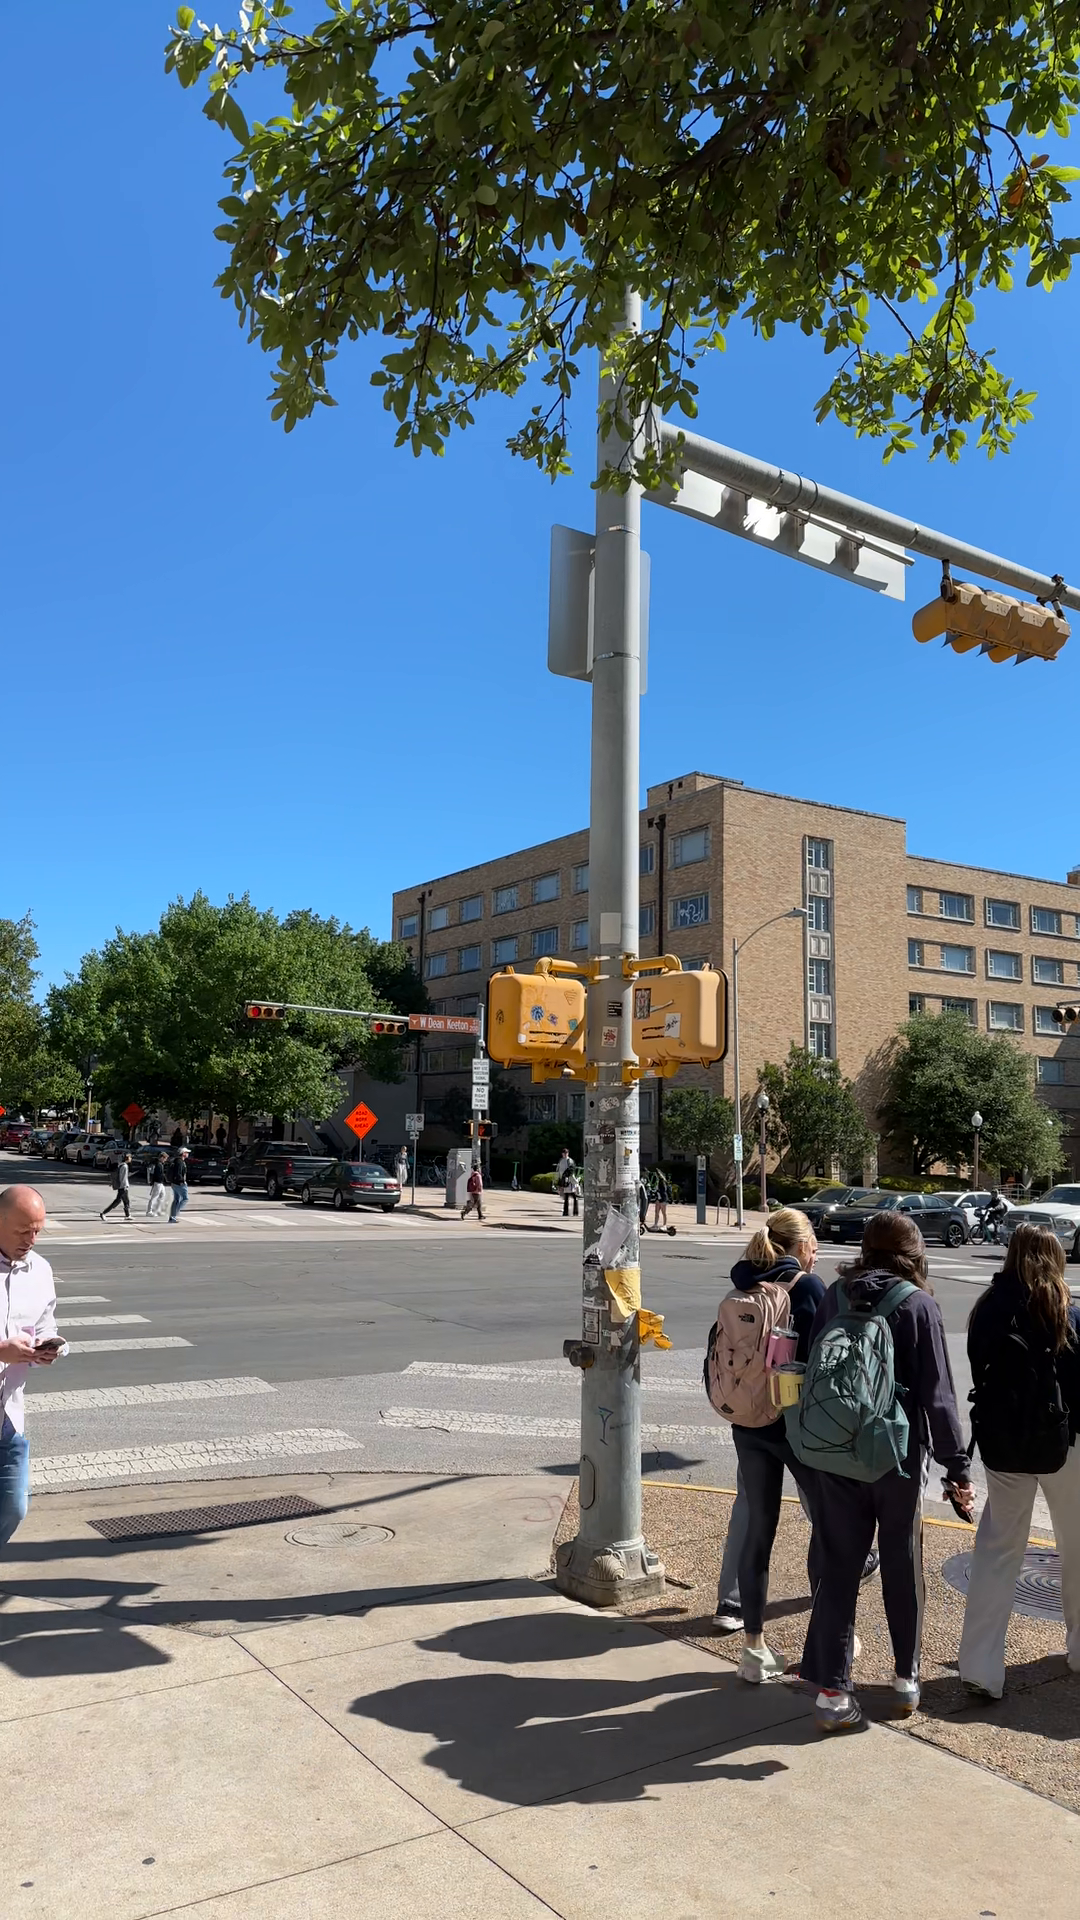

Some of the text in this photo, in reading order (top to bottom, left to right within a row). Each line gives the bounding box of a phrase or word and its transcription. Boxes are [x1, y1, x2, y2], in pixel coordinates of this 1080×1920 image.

[420, 1017, 468, 1030] W Dean Keeton
